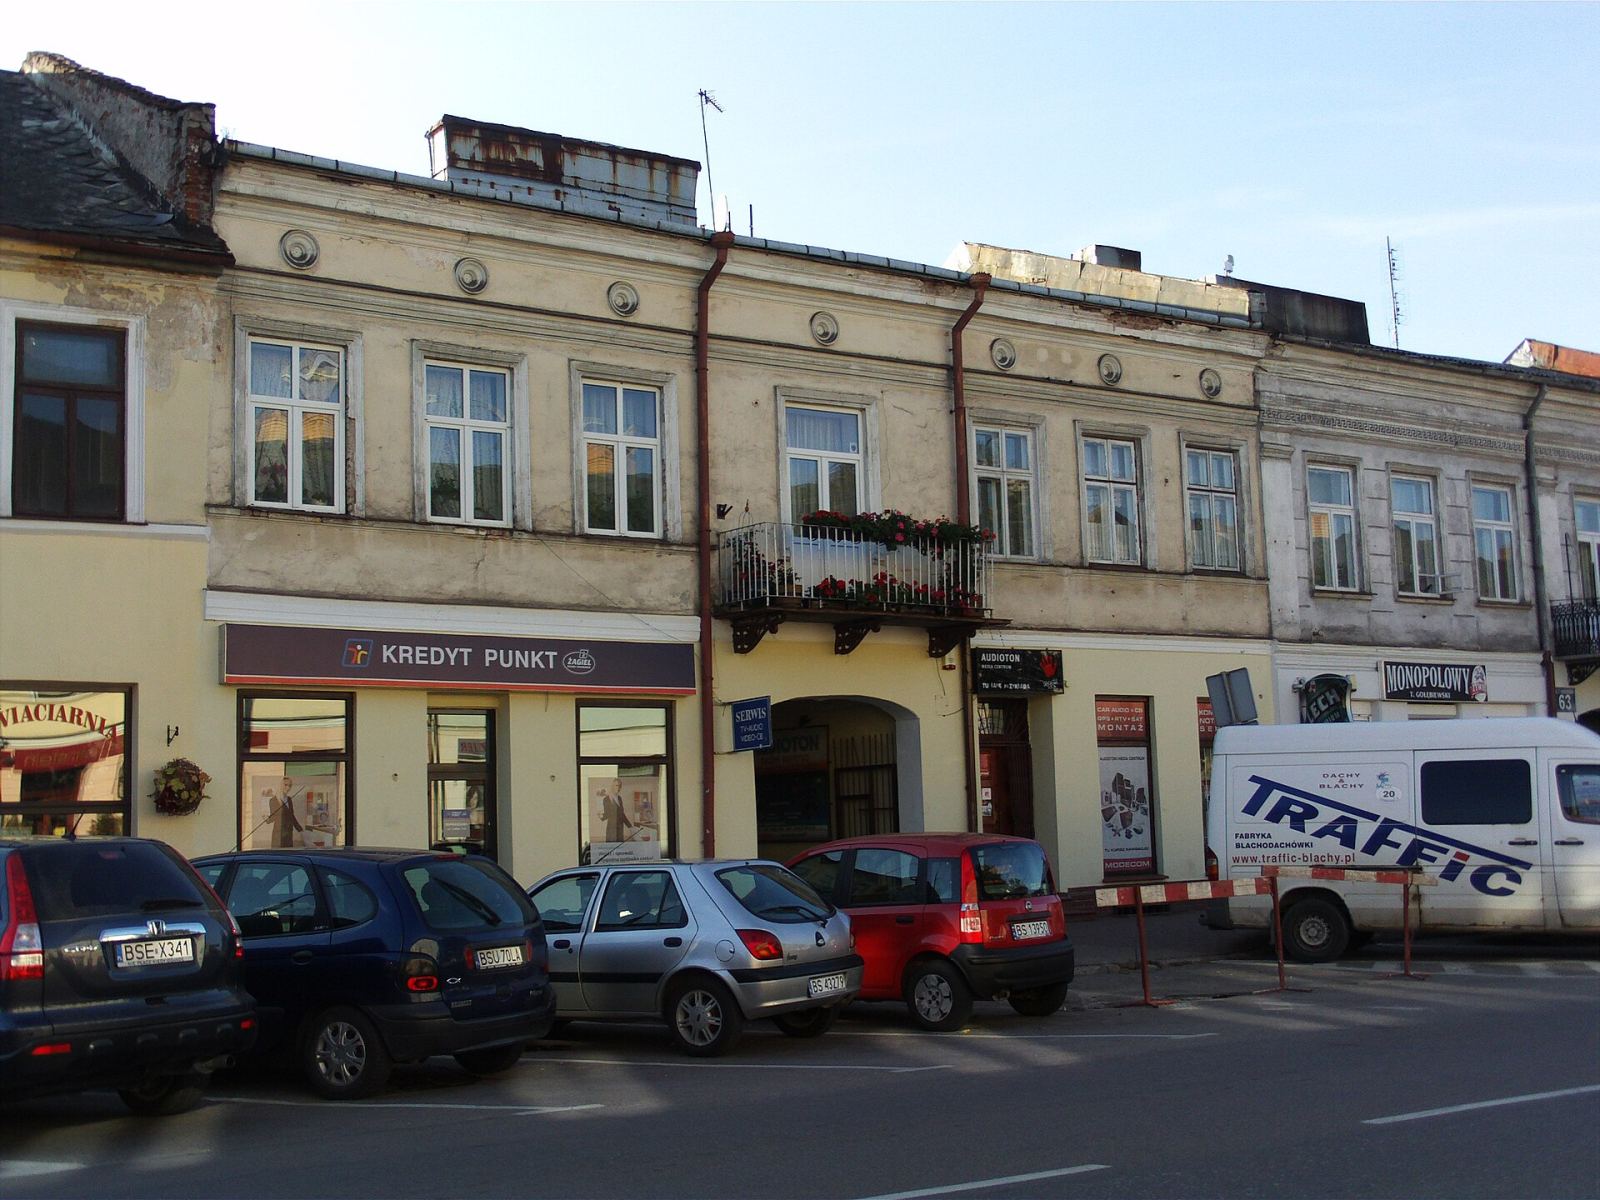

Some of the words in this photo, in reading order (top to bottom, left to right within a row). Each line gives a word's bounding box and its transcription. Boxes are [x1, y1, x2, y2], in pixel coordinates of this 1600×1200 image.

[382, 644, 473, 666] KREDYT
[485, 649, 558, 669] PUNKT
[981, 653, 1020, 662] AUDIOTON
[1386, 665, 1470, 694] MONOPOLOWY
[1559, 694, 1571, 710] 63
[735, 707, 767, 723] SERWIS
[1098, 723, 1144, 731] MONTAŻ
[1383, 790, 1395, 798] 20
[1235, 840, 1313, 849] BLACHODACHÓWKI
[1104, 860, 1150, 869] MODECOM
[1232, 853, 1356, 865] www.traffic-blachy.pl
[1015, 924, 1028, 936] BS
[124, 943, 154, 961] BSE
[160, 941, 190, 957] X341
[479, 949, 500, 966] BSU
[812, 979, 823, 993] BS
[824, 976, 844, 991] 43279
